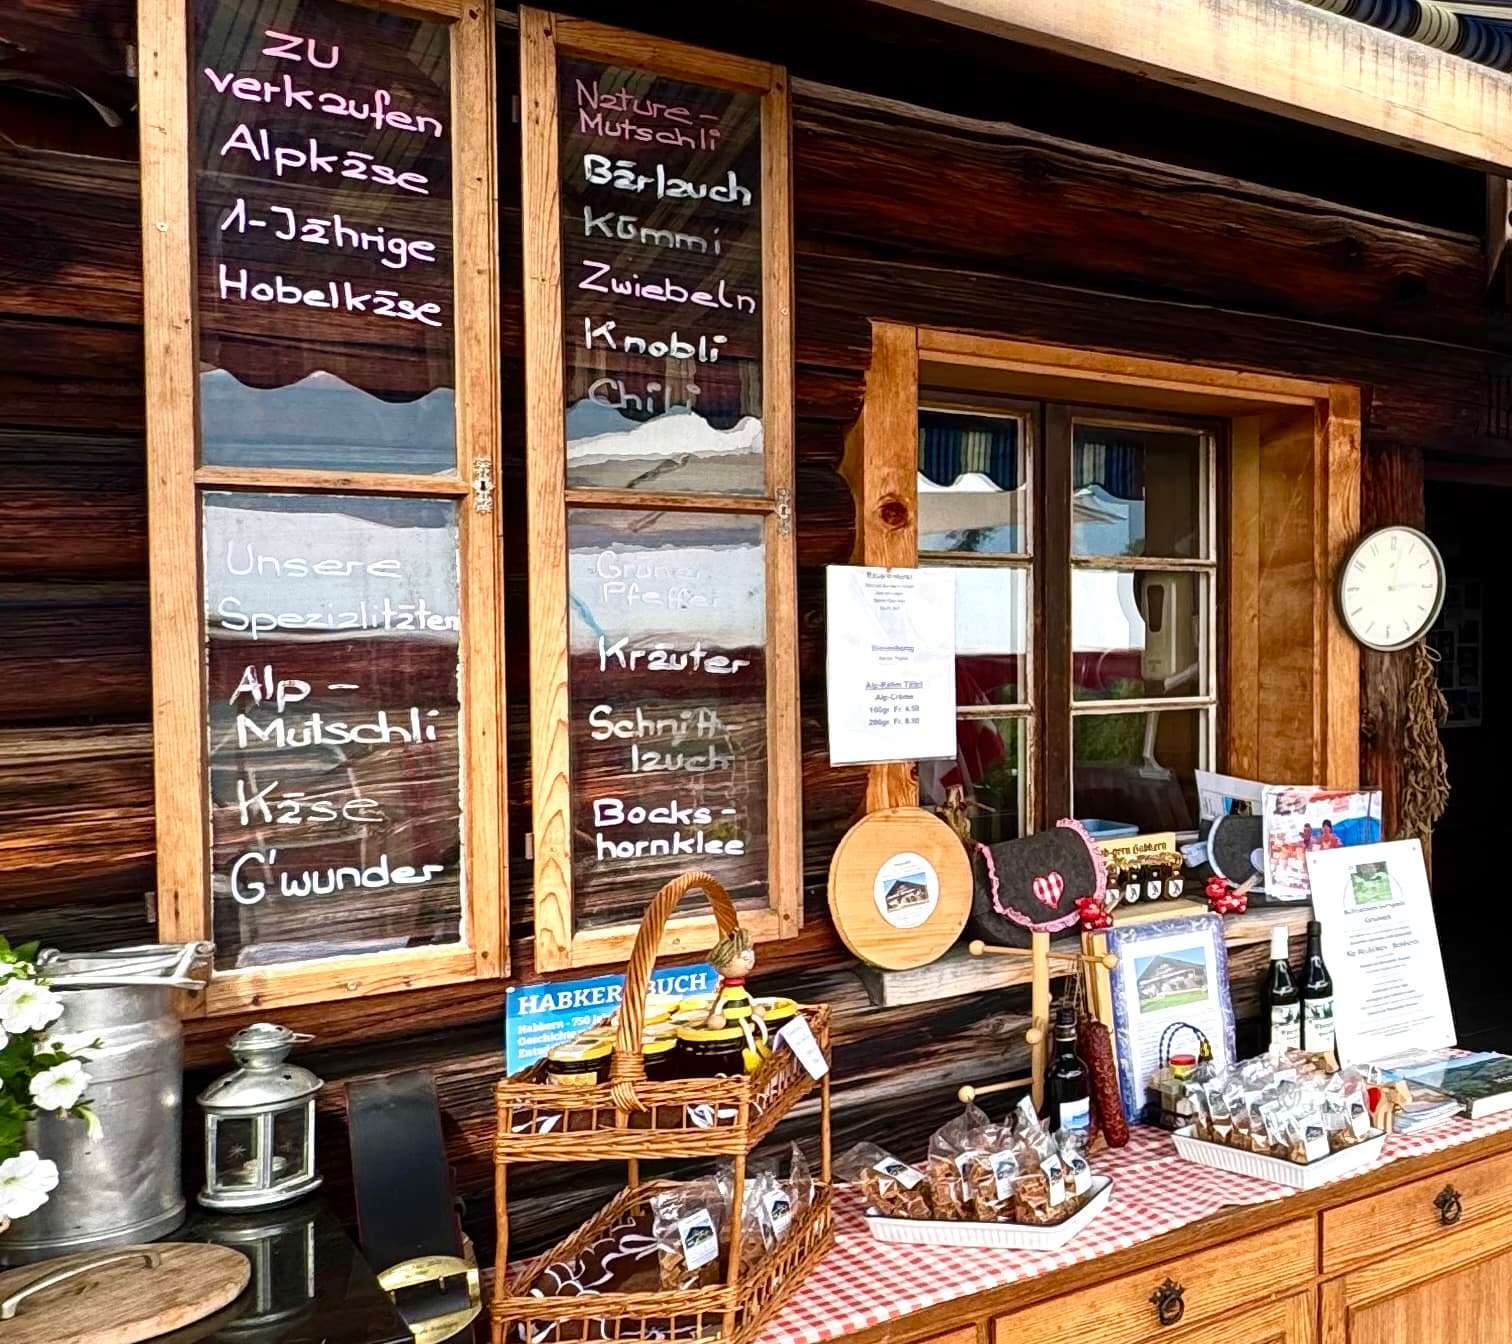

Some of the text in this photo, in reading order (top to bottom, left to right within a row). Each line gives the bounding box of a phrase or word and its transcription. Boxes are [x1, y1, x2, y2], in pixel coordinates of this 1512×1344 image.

[205, 67, 443, 138] verkaufen
[579, 108, 720, 150] Mutschli
[221, 124, 430, 195] Alpkäse
[583, 154, 752, 206] Bärlauch
[219, 264, 443, 327] Hobelkäse
[578, 259, 756, 315] Zwiebeln
[584, 317, 727, 363] Knobli
[226, 541, 402, 578] Unsere
[598, 636, 751, 674] Kräuter
[236, 708, 440, 750] Mutschli
[236, 780, 386, 826] Käse
[596, 830, 745, 861] hornklee
[230, 852, 445, 905] G'wunder
